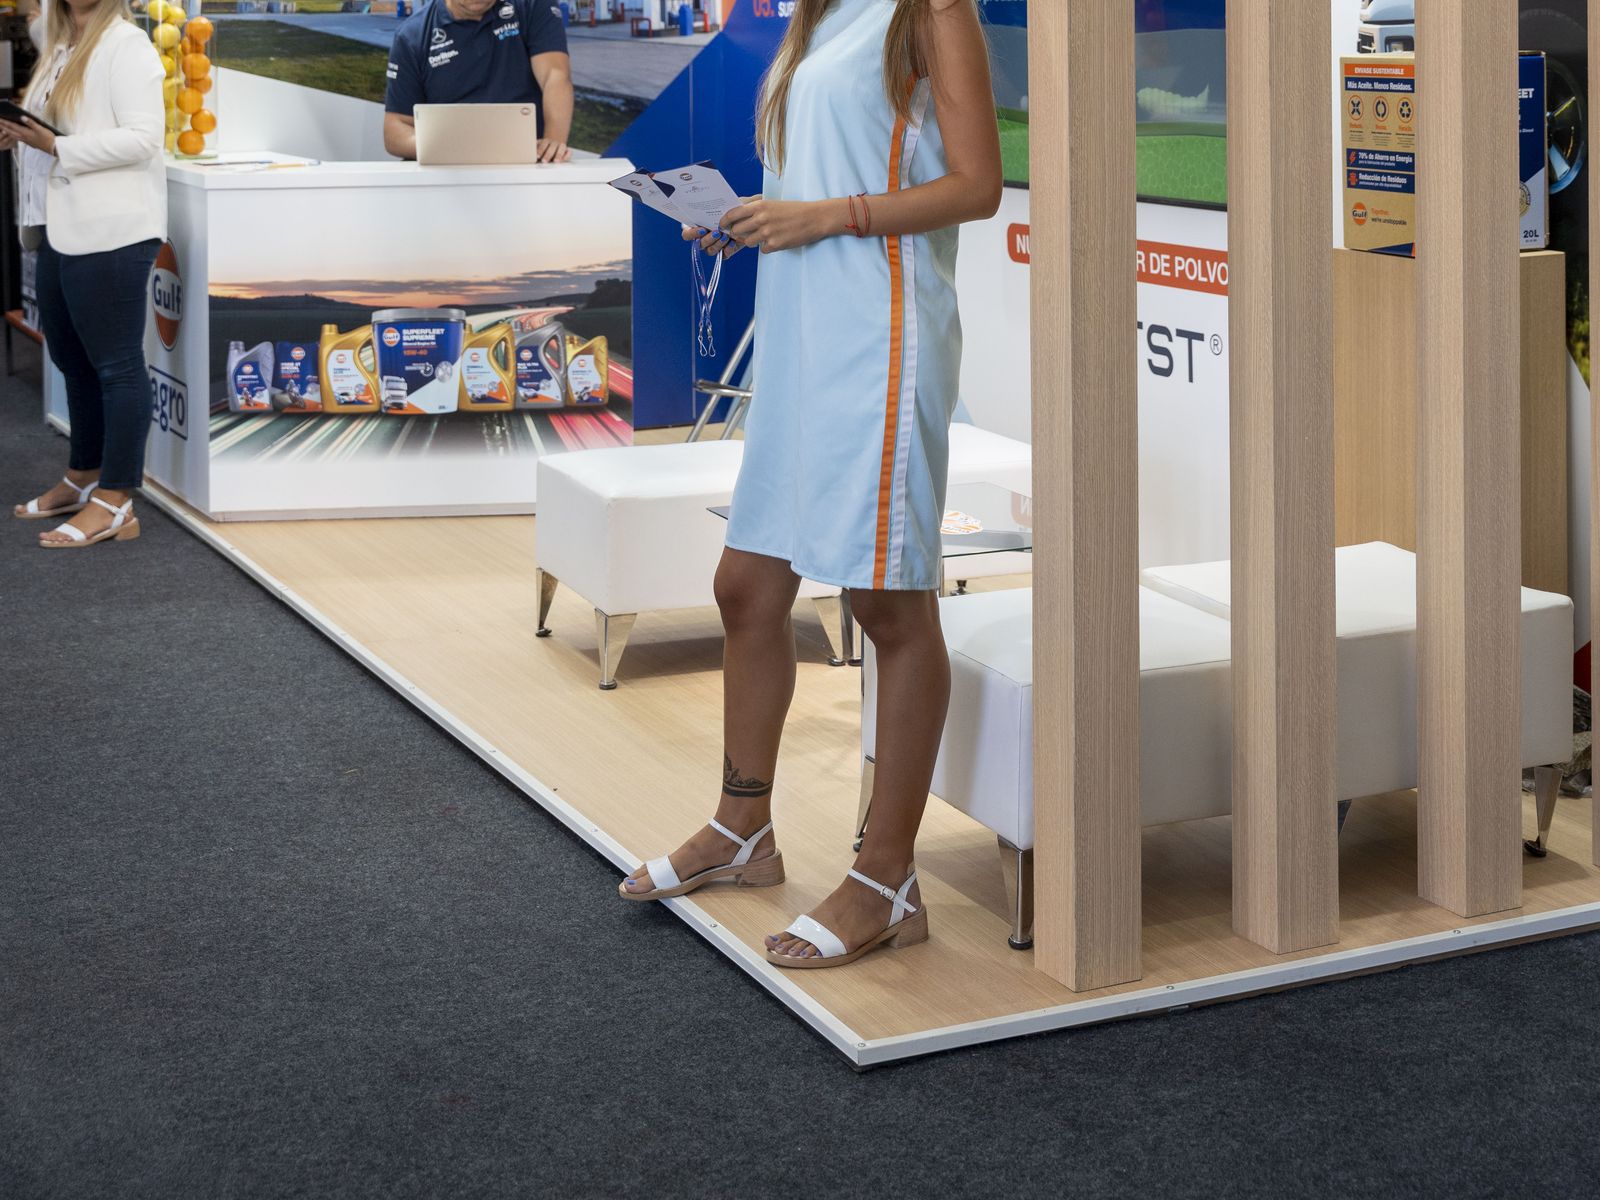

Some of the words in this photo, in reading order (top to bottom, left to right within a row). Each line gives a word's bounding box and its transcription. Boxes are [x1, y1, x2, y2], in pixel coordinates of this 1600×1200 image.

[1352, 209, 1367, 218] Gulf
[1523, 230, 1539, 238] 20L
[1150, 252, 1171, 277] DE
[153, 273, 182, 315] Gulf
